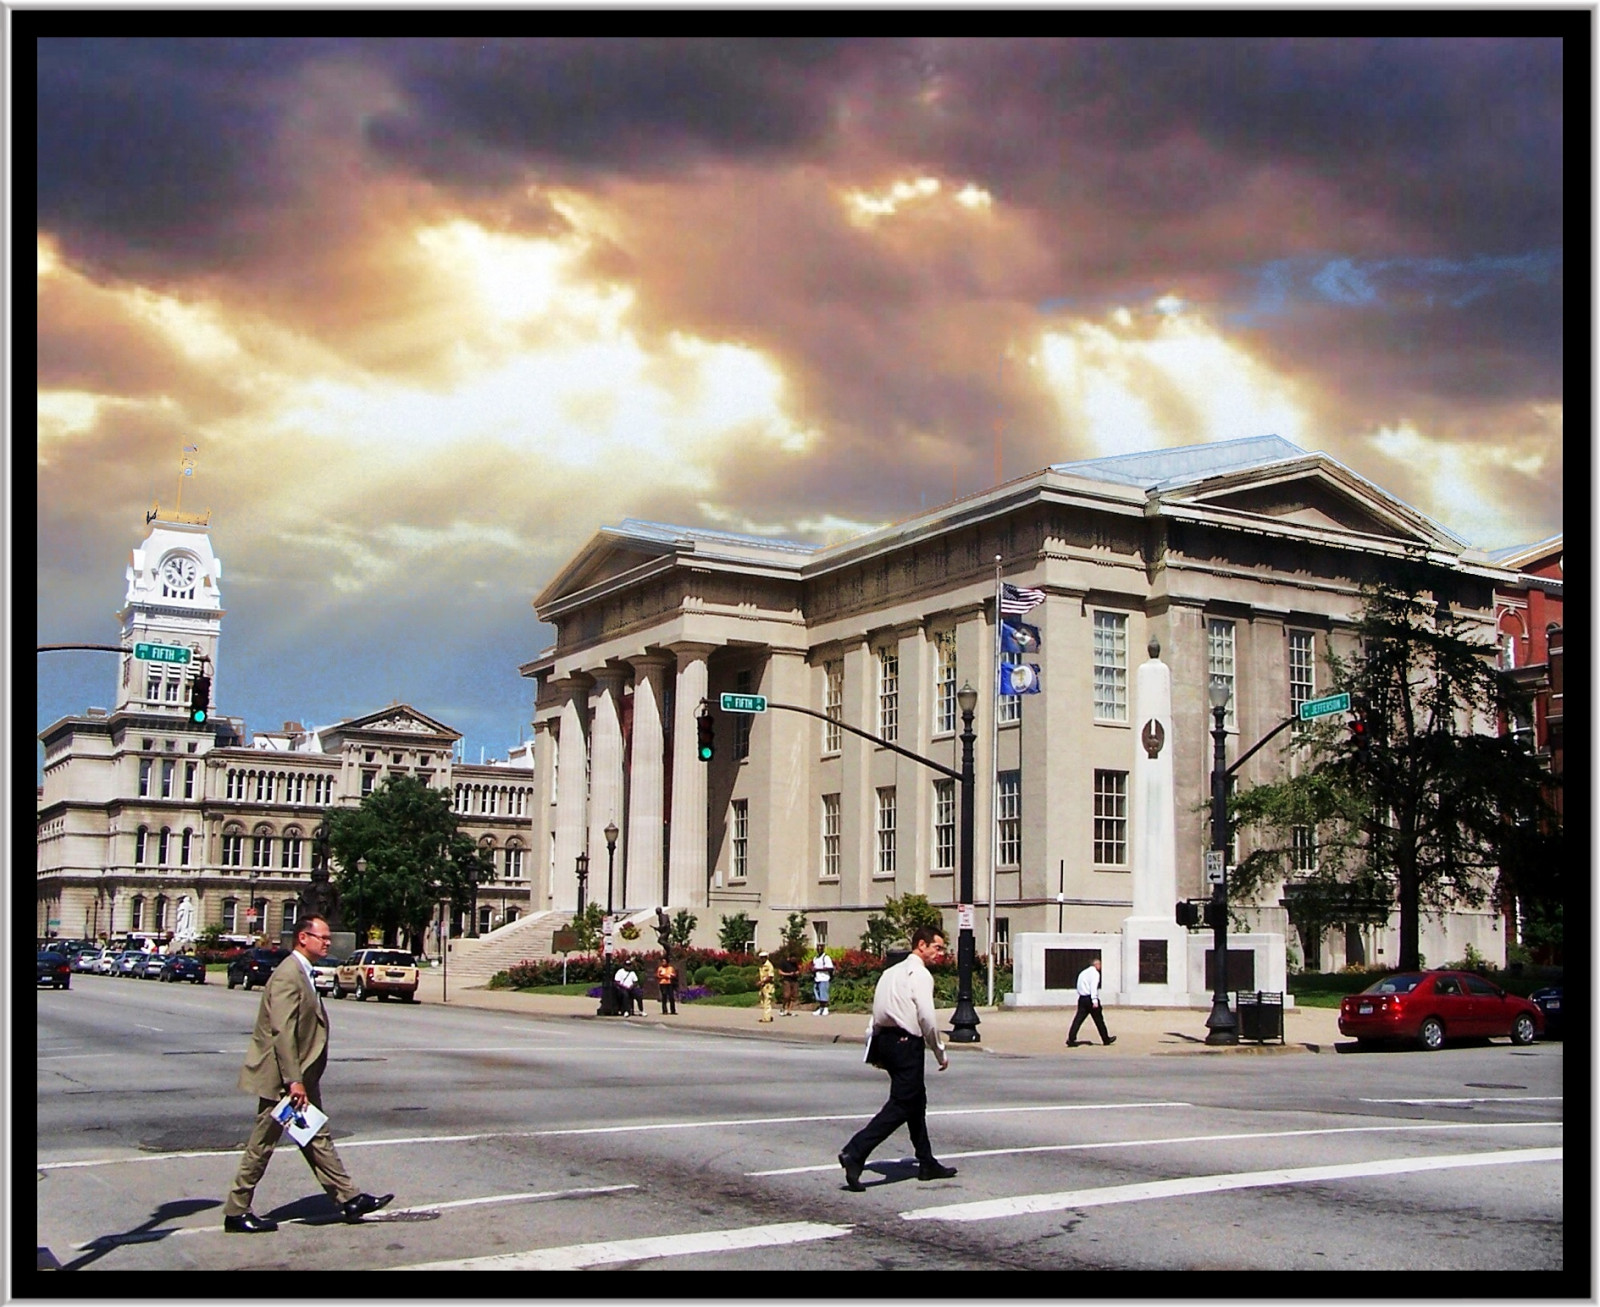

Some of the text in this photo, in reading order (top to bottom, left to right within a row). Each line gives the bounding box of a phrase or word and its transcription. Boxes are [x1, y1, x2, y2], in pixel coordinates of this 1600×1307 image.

[151, 647, 175, 660] FIFTH
[735, 697, 753, 709] FIFTH
[1311, 698, 1341, 715] JEFFERSON
[1208, 853, 1221, 863] ONE
